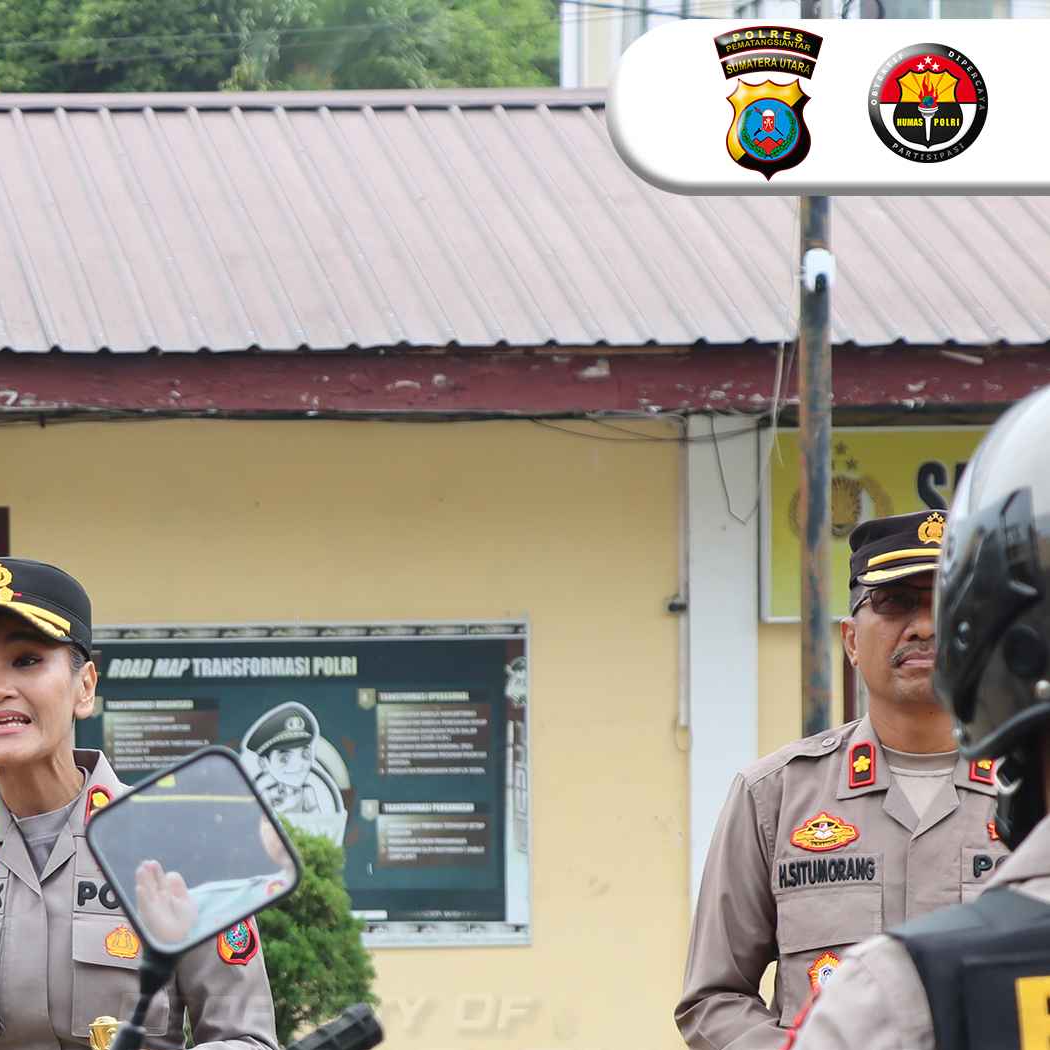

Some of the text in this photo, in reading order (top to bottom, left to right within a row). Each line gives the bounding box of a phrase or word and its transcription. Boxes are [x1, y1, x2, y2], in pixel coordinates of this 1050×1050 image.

[107, 655, 358, 679] ROAD MAP TRANSFORMASI POLRI
[778, 856, 876, 889] H.SITUMORANG
